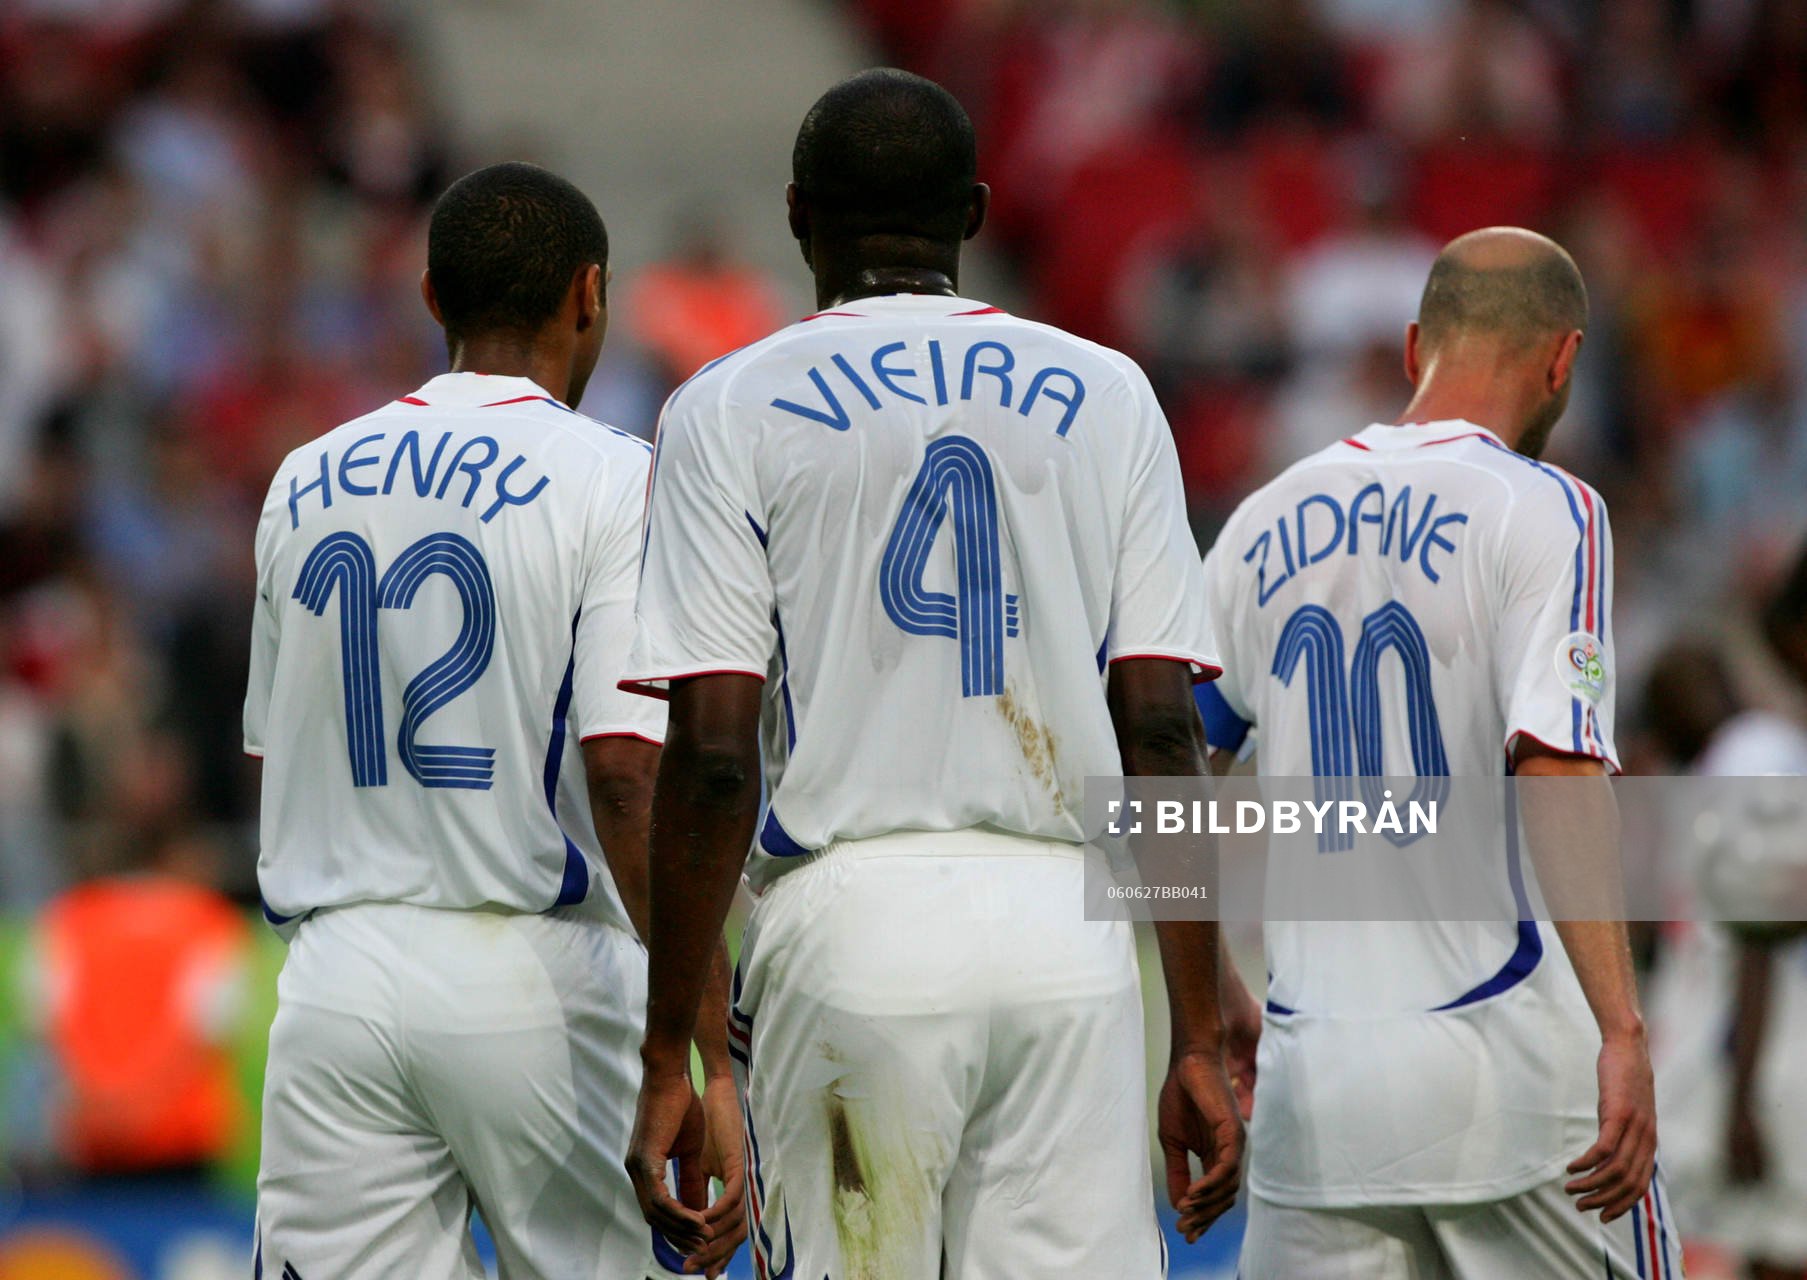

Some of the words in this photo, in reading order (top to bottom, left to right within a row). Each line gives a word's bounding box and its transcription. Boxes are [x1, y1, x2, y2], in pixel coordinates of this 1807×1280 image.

[287, 429, 550, 530] HENRY
[771, 339, 1087, 437] VIEIRA
[879, 434, 1020, 699] 4
[1243, 482, 1470, 609] ZIDANE
[291, 530, 496, 791] 12
[1270, 598, 1451, 855] 10
